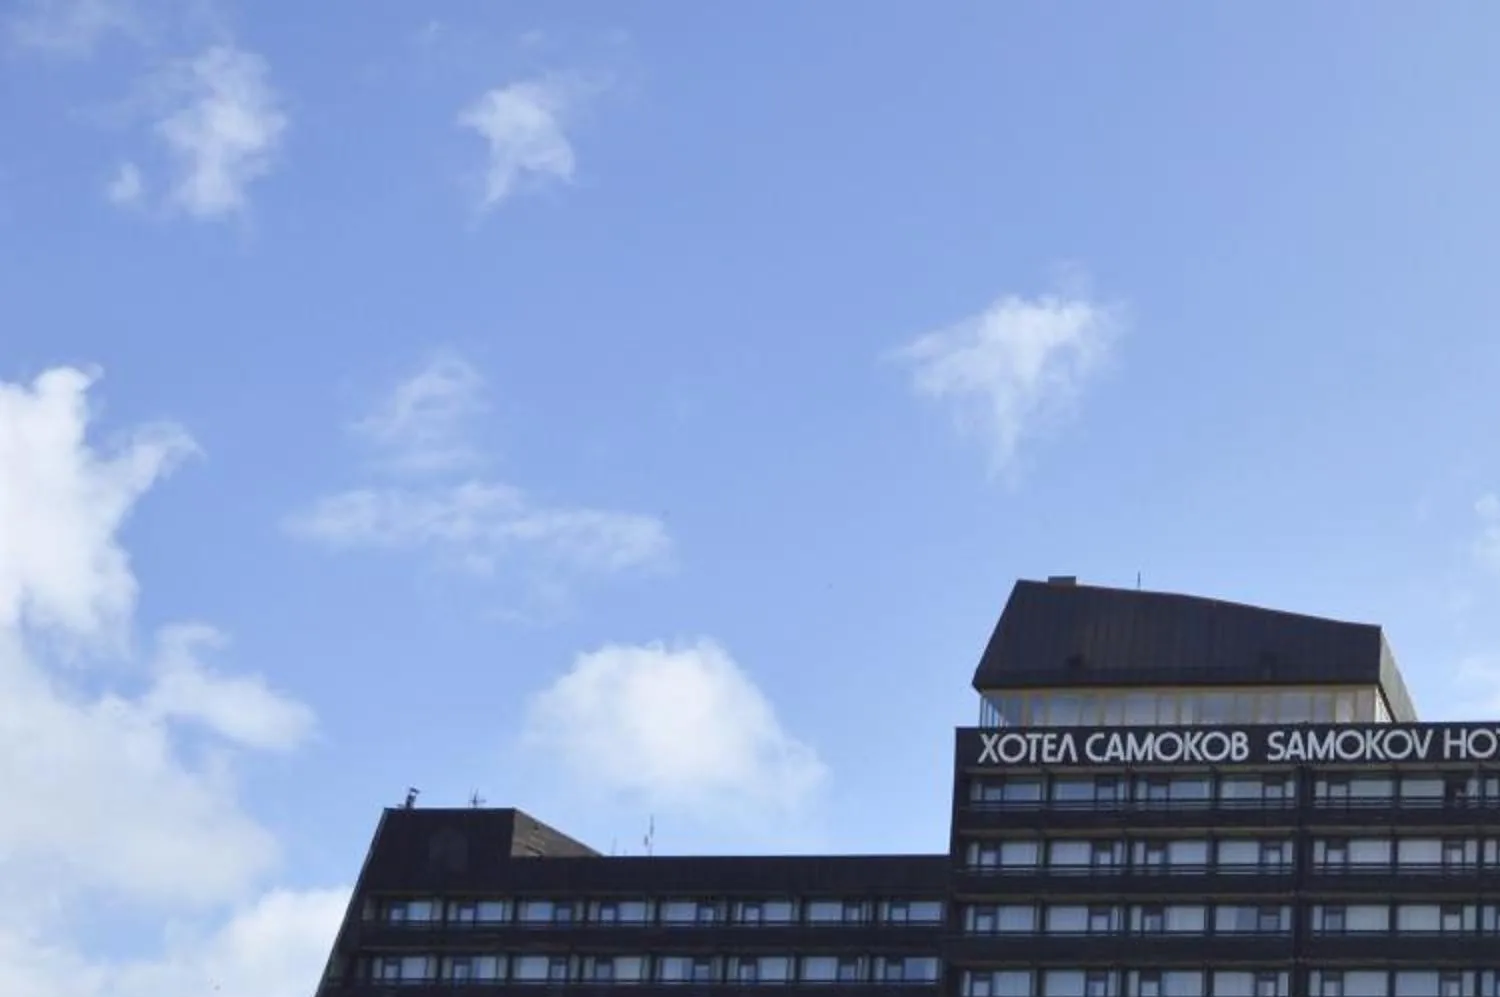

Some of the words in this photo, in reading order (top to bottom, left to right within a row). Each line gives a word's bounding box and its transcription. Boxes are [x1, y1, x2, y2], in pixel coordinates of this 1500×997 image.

[978, 733, 1078, 763] ХОТЕЛ
[1085, 731, 1250, 763] САМОКОВ
[1267, 729, 1434, 761] SAMOKOV
